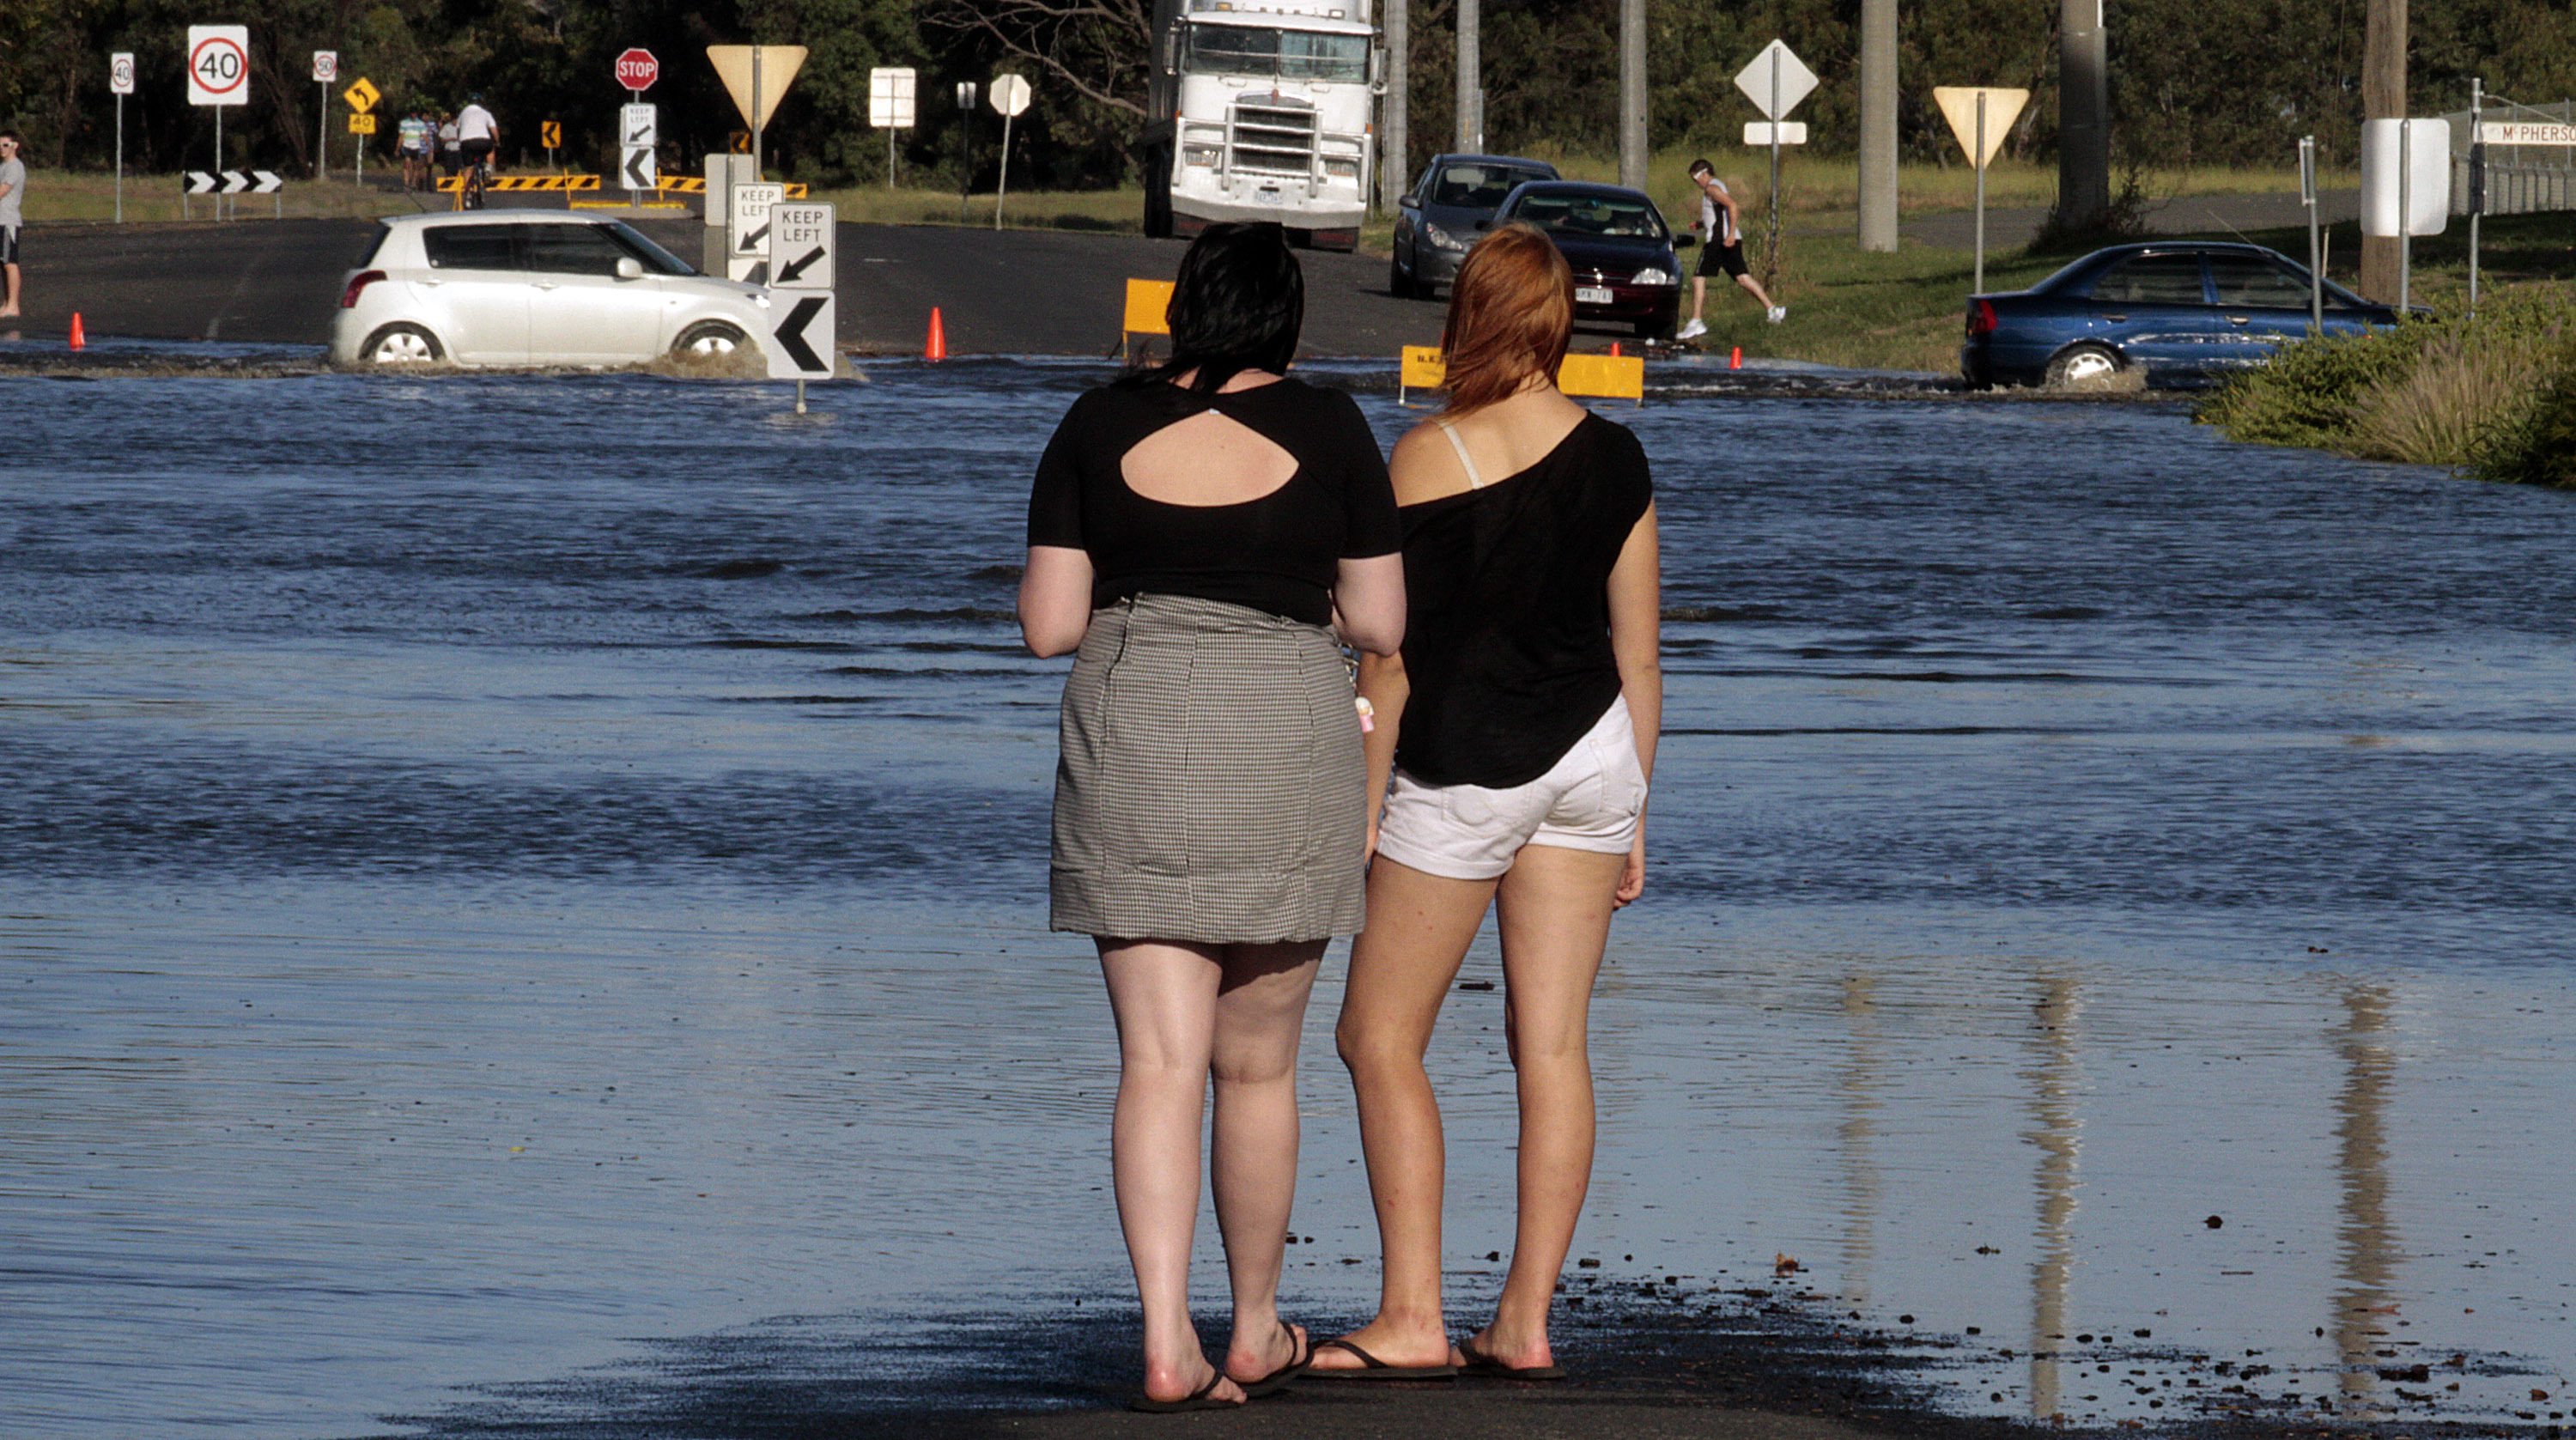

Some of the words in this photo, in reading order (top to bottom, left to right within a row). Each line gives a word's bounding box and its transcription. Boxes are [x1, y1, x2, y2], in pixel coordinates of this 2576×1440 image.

[198, 52, 239, 79] 40
[619, 60, 655, 77] STOP
[115, 67, 130, 80] 40
[741, 190, 775, 202] KEEP
[782, 210, 823, 224] KEEP
[783, 228, 821, 242] LEFT
